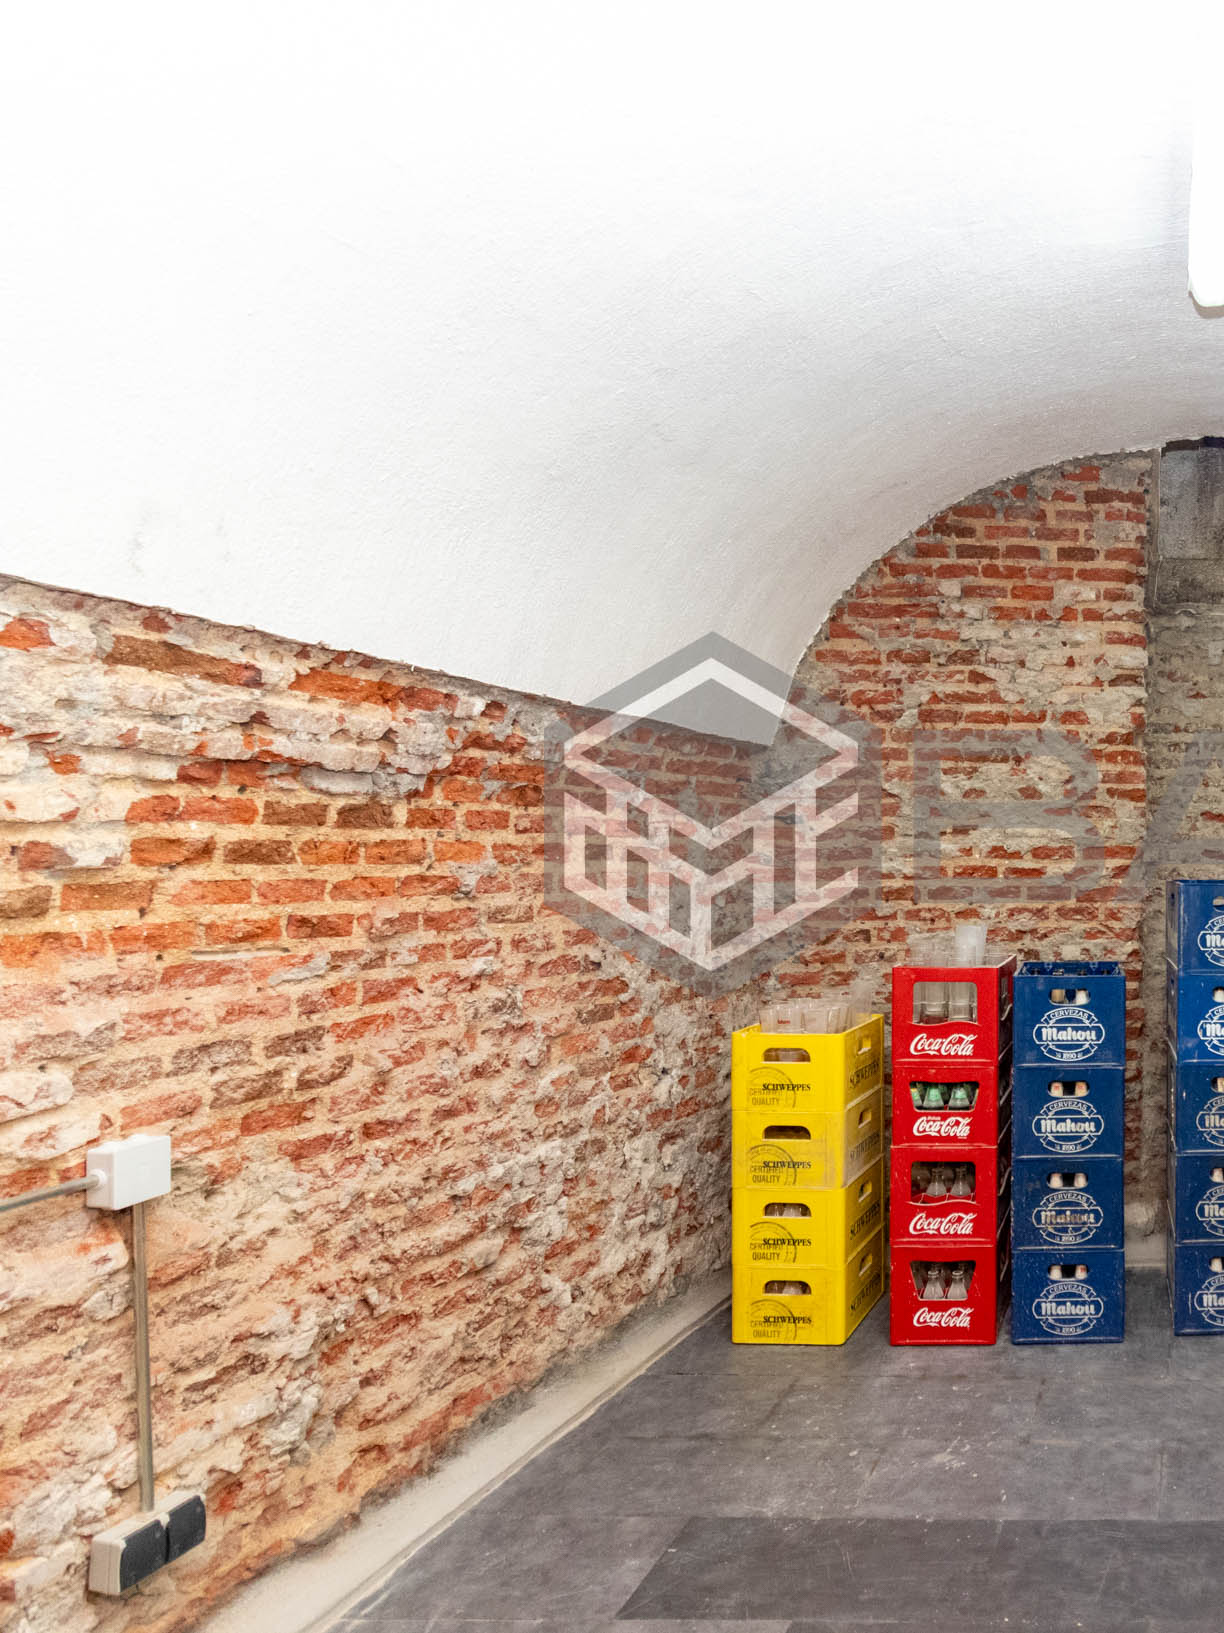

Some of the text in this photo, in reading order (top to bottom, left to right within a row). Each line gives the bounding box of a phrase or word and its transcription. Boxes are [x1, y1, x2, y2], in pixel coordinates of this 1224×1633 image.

[1050, 1009, 1088, 1019] CERVEZAS
[1041, 1027, 1097, 1041] Mahou
[910, 1033, 977, 1056] Coca-Cola
[850, 1058, 880, 1089] SCHWEPPES
[762, 1083, 811, 1091] SCHWEPPES
[752, 1097, 780, 1106] QUALITY
[1049, 1101, 1087, 1110] CERVEZAS
[913, 1116, 973, 1137] Coca-Cola
[1040, 1119, 1096, 1133] Mahou
[763, 1161, 812, 1169] SCHWEPPES
[752, 1175, 781, 1183] QUALITY
[1049, 1193, 1087, 1203] CERVEZAS
[850, 1202, 880, 1240] SCHWEPPES
[1041, 1211, 1095, 1224] Mahou
[909, 1212, 977, 1235] Coca-Cola
[763, 1238, 812, 1246] SCHWEPPES
[752, 1251, 781, 1261] QUALITY
[1049, 1284, 1087, 1294] CERVEZAS
[1041, 1302, 1095, 1316] Mahou
[763, 1316, 812, 1324] SCHWEPPES
[913, 1307, 974, 1327] Coca-Cola
[753, 1329, 781, 1338] QUALITY
